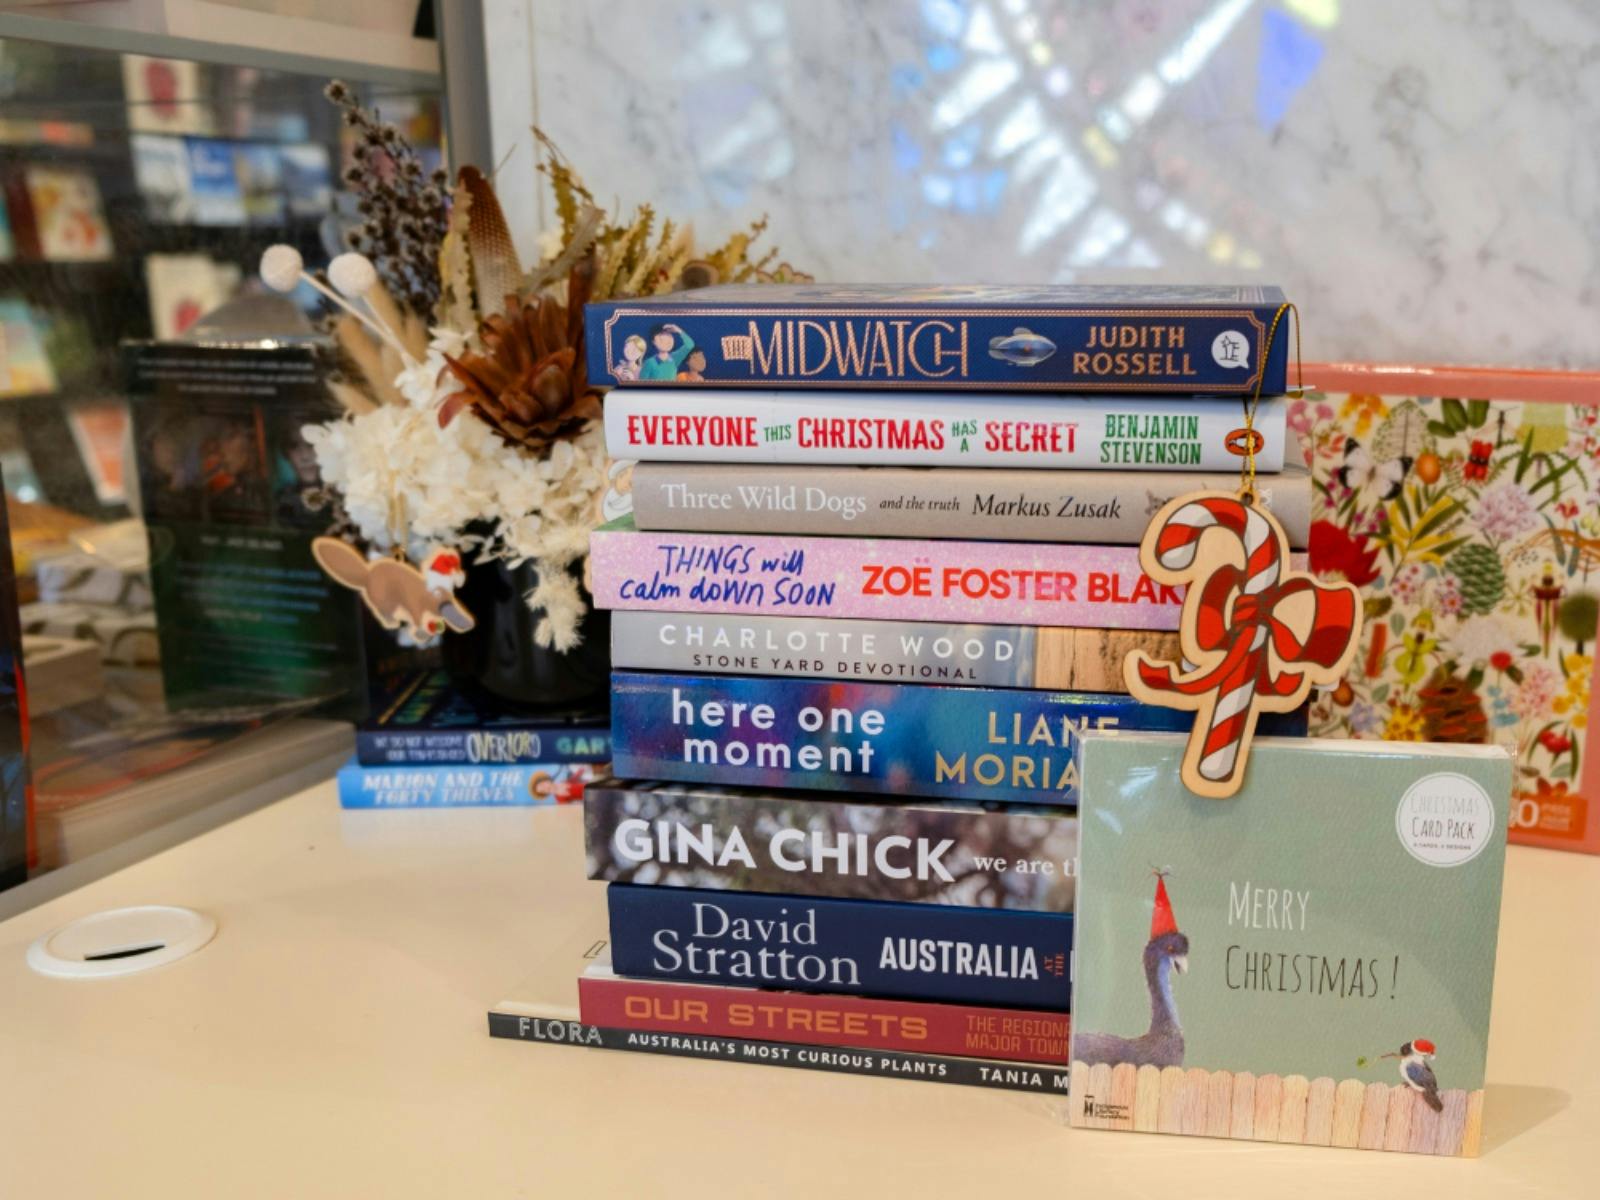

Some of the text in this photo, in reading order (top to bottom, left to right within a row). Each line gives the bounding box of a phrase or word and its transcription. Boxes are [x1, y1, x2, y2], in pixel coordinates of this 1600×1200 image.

[749, 320, 968, 377] MIDWATCH
[1086, 325, 1186, 349] JUDITH
[1073, 352, 1197, 377] ROSSELL
[627, 415, 945, 450] EVERYONE THIS CHRISTMAS
[951, 420, 978, 437] HAS
[984, 421, 1079, 453] SECRET
[1104, 413, 1200, 441] BENJAMIN
[960, 438, 969, 453] A
[1100, 442, 1202, 465] STEVENSON
[660, 483, 867, 520] Three Wild Dogs
[879, 496, 960, 512] and the truth
[972, 494, 1121, 519] Markus Zusak
[657, 545, 804, 577] THINGS will
[620, 571, 681, 600] calm
[862, 557, 1192, 606] ZOË FOSTER BLAK
[659, 624, 1014, 662] CHARLOTTE WOOD
[694, 654, 978, 680] STONE YARD DEVOTIONAL
[672, 688, 886, 735] here one
[556, 736, 612, 755] GAR
[684, 736, 875, 774] moment
[442, 770, 485, 788] AND
[490, 769, 524, 786] THE
[1412, 816, 1476, 840] CARD PACK
[615, 819, 955, 883] GINA CHICK
[973, 856, 1007, 873] we
[1015, 858, 1055, 877] are
[1228, 881, 1310, 931] MERRY
[692, 903, 818, 946] David
[652, 929, 861, 985] Stratton
[879, 936, 1039, 980] AUSTRALIA
[1225, 945, 1379, 999] CHRISTMAS
[518, 1017, 602, 1045] FLORA
[624, 996, 928, 1040] OUR STREETS
[966, 1015, 997, 1034] THE
[628, 1032, 948, 1077] AUSTRALIA'S MOST CURIOUS PLANTS
[965, 1033, 1021, 1053] MAJOR
[980, 1066, 1042, 1087] TANIA
